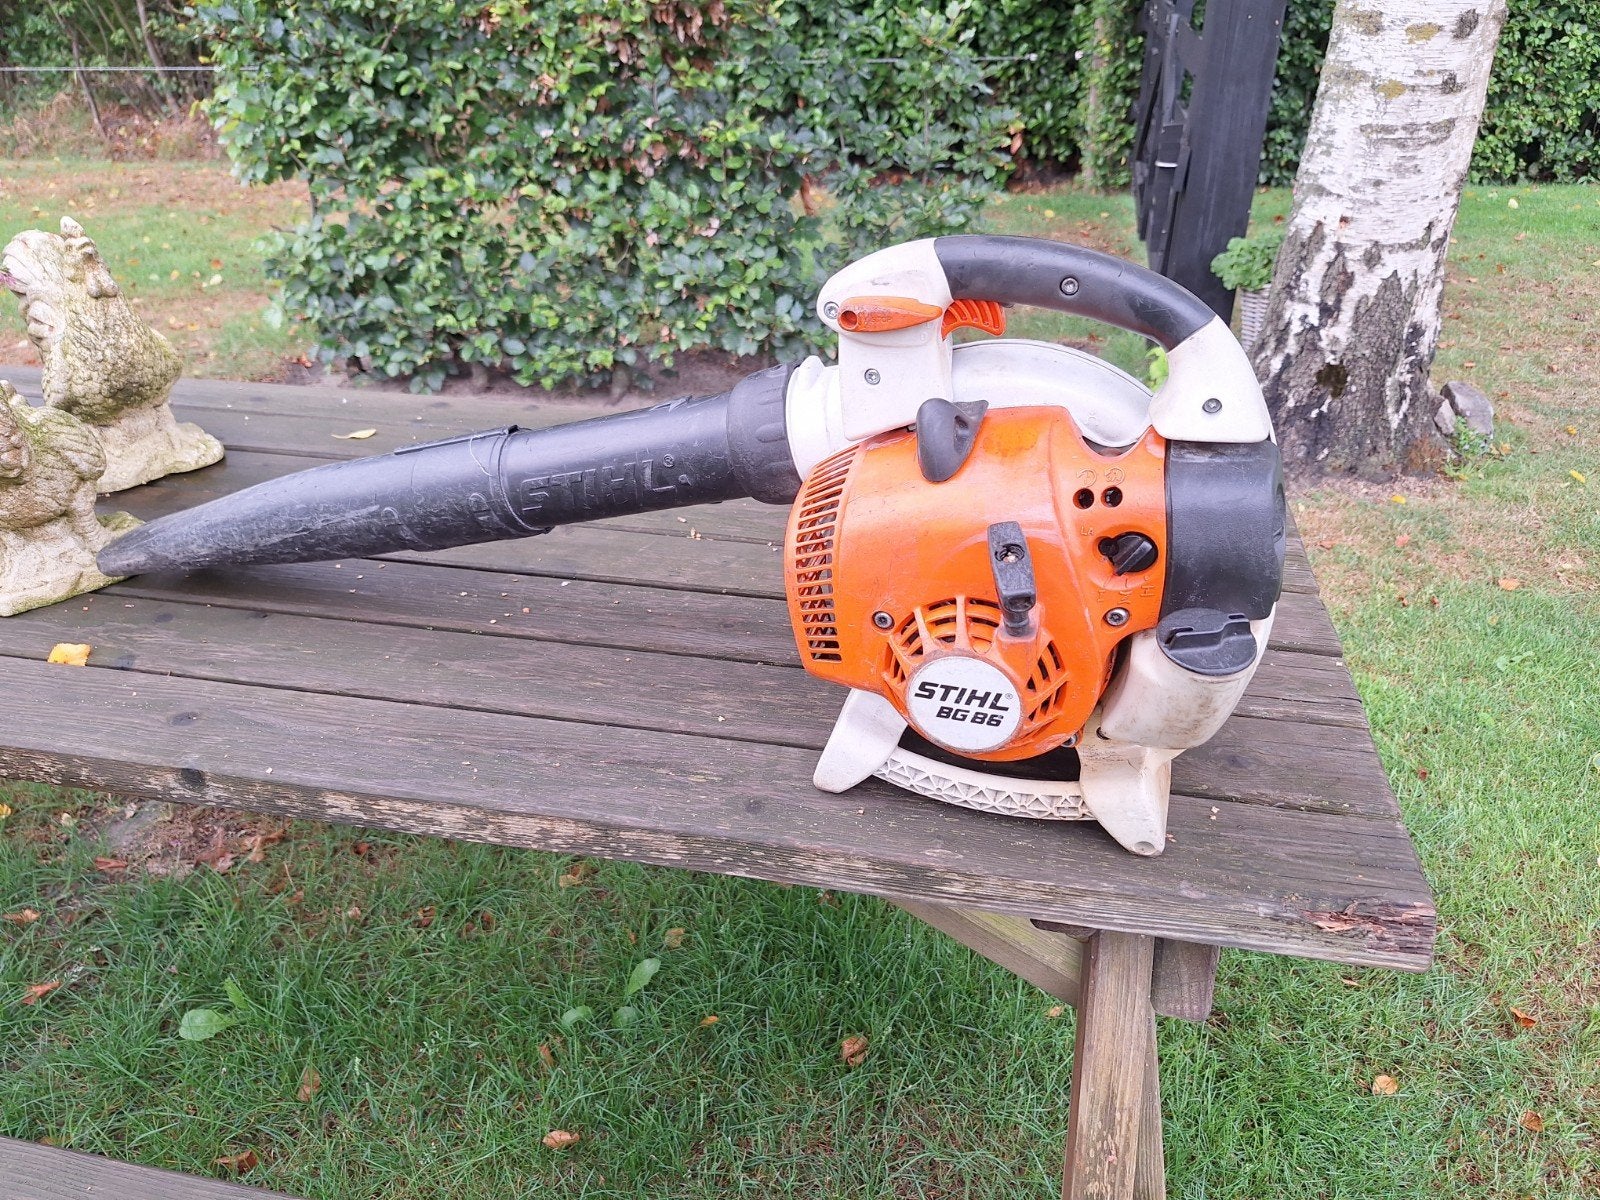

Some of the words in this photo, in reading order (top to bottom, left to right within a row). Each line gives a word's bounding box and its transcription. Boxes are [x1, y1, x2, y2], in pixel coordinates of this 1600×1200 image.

[914, 681, 1010, 712] STIHL
[936, 706, 970, 722] BG
[970, 712, 1004, 727] 86
